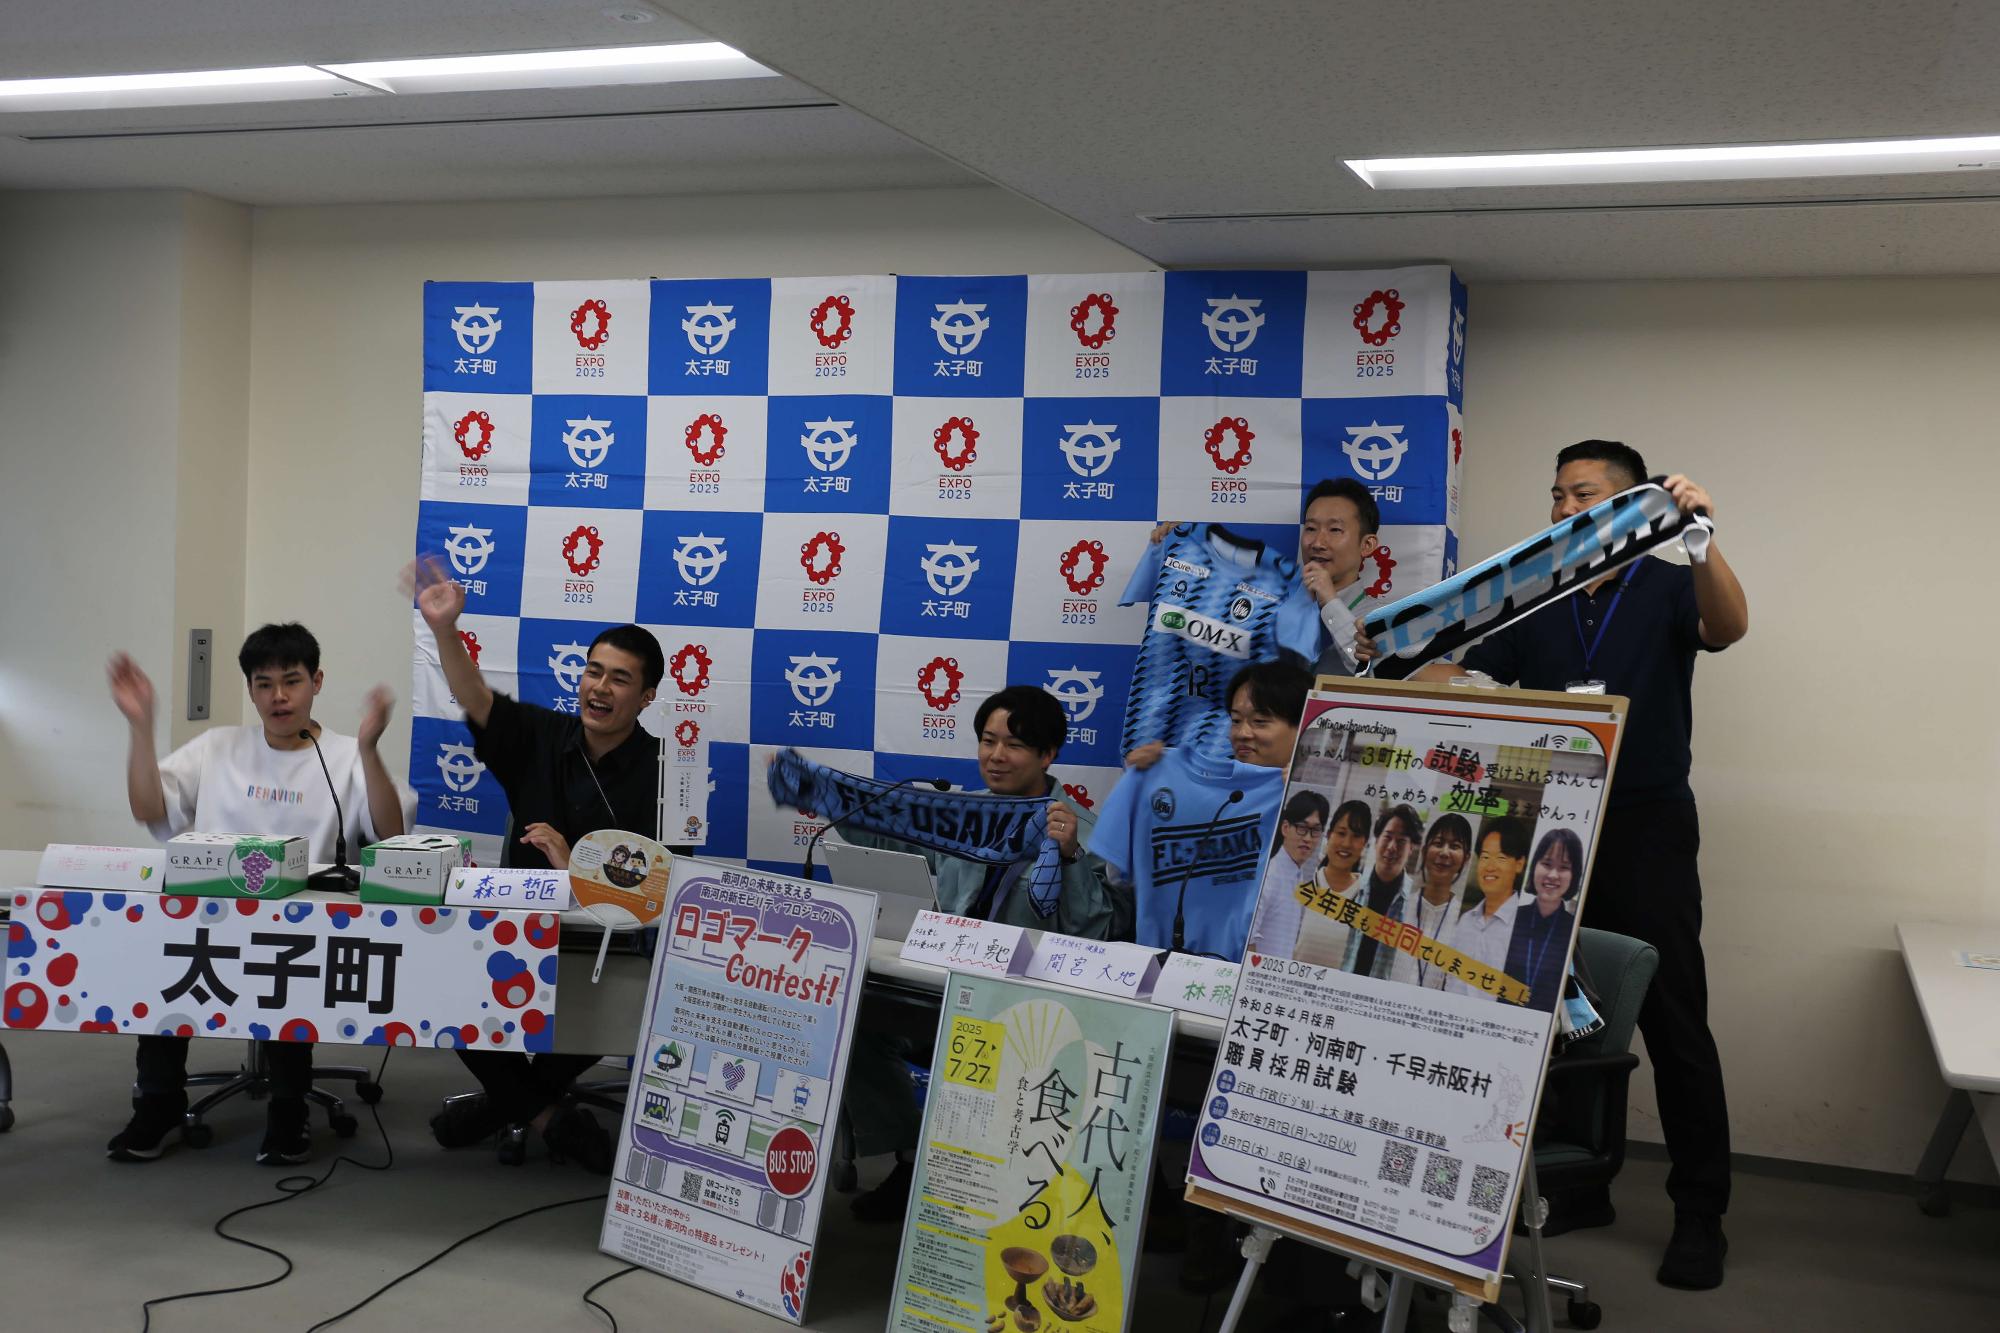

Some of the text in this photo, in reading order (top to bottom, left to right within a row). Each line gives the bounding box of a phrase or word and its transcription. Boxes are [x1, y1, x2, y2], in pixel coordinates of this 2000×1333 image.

[455, 358, 497, 374] 太子町
[576, 356, 604, 367] EXPO
[686, 360, 730, 375] 太子町
[815, 355, 848, 367] EXPO
[1073, 355, 1110, 368] EXPO
[1205, 357, 1257, 375] 太子町
[1356, 352, 1396, 367] EXPO
[576, 368, 604, 379] 2025
[816, 367, 845, 378] 2025
[934, 360, 983, 376] 太子町
[1074, 368, 1111, 380] 2025
[1358, 366, 1392, 379] 2025
[459, 466, 489, 476] EXPO
[689, 472, 720, 483] EXPO
[459, 477, 487, 488] 2025
[565, 472, 608, 489] 太子町
[804, 477, 851, 492] 太子町
[938, 478, 972, 489] EXPO
[1210, 479, 1248, 491] EXPO
[687, 484, 720, 495] 2025
[937, 490, 972, 501] 2025
[1064, 482, 1114, 499] 太子町
[1367, 486, 1404, 503] 子町
[1210, 492, 1248, 505] 2025
[562, 582, 596, 592] EXPO
[564, 593, 592, 603] 2025
[674, 590, 719, 607] 太子町
[803, 590, 836, 601] EXPO
[801, 603, 832, 612] 2025
[922, 600, 970, 618] 太子町
[1062, 602, 1097, 612] EXPO
[1060, 613, 1098, 625] 2025
[1187, 622, 1243, 652] OM-X
[553, 696, 580, 713] 太子
[789, 711, 835, 728] 太子町
[921, 719, 957, 730] EXPO
[921, 731, 956, 741] 2025
[1066, 727, 1097, 745] 子町
[1317, 717, 1397, 745] Minamikawachigun
[247, 785, 304, 806] BEHAVIOR
[439, 795, 479, 813] 太子町
[794, 825, 825, 836] EXPO
[794, 836, 824, 846] 205
[170, 855, 224, 867] GRAPE
[384, 866, 432, 877] GRAPE
[473, 875, 559, 900] 森口 哲匠
[721, 871, 812, 899] 南河内の未来を支える
[701, 885, 840, 924] 南河内新モビリティプロジェクト
[675, 906, 812, 963] ロゴマーク
[161, 928, 402, 1015] 太子町
[1044, 953, 1136, 987] 間宮 大地
[1262, 957, 1283, 973] 2025
[725, 953, 840, 1006] Contest!
[1183, 979, 1206, 1001] 林
[1238, 996, 1336, 1030] 令和8年4月採用
[956, 1021, 982, 1035] 2025
[1230, 1016, 1493, 1099] 太子町・河南町・千早赤阪村
[1223, 1041, 1360, 1097] 職員採用試験
[1019, 1068, 1079, 1230] 食べる
[769, 1152, 814, 1174] BUS STOP
[705, 1178, 741, 1197] QRコードでの
[617, 1188, 690, 1222] 投票いただいた方の中から
[703, 1187, 739, 1207] 投票はこちら
